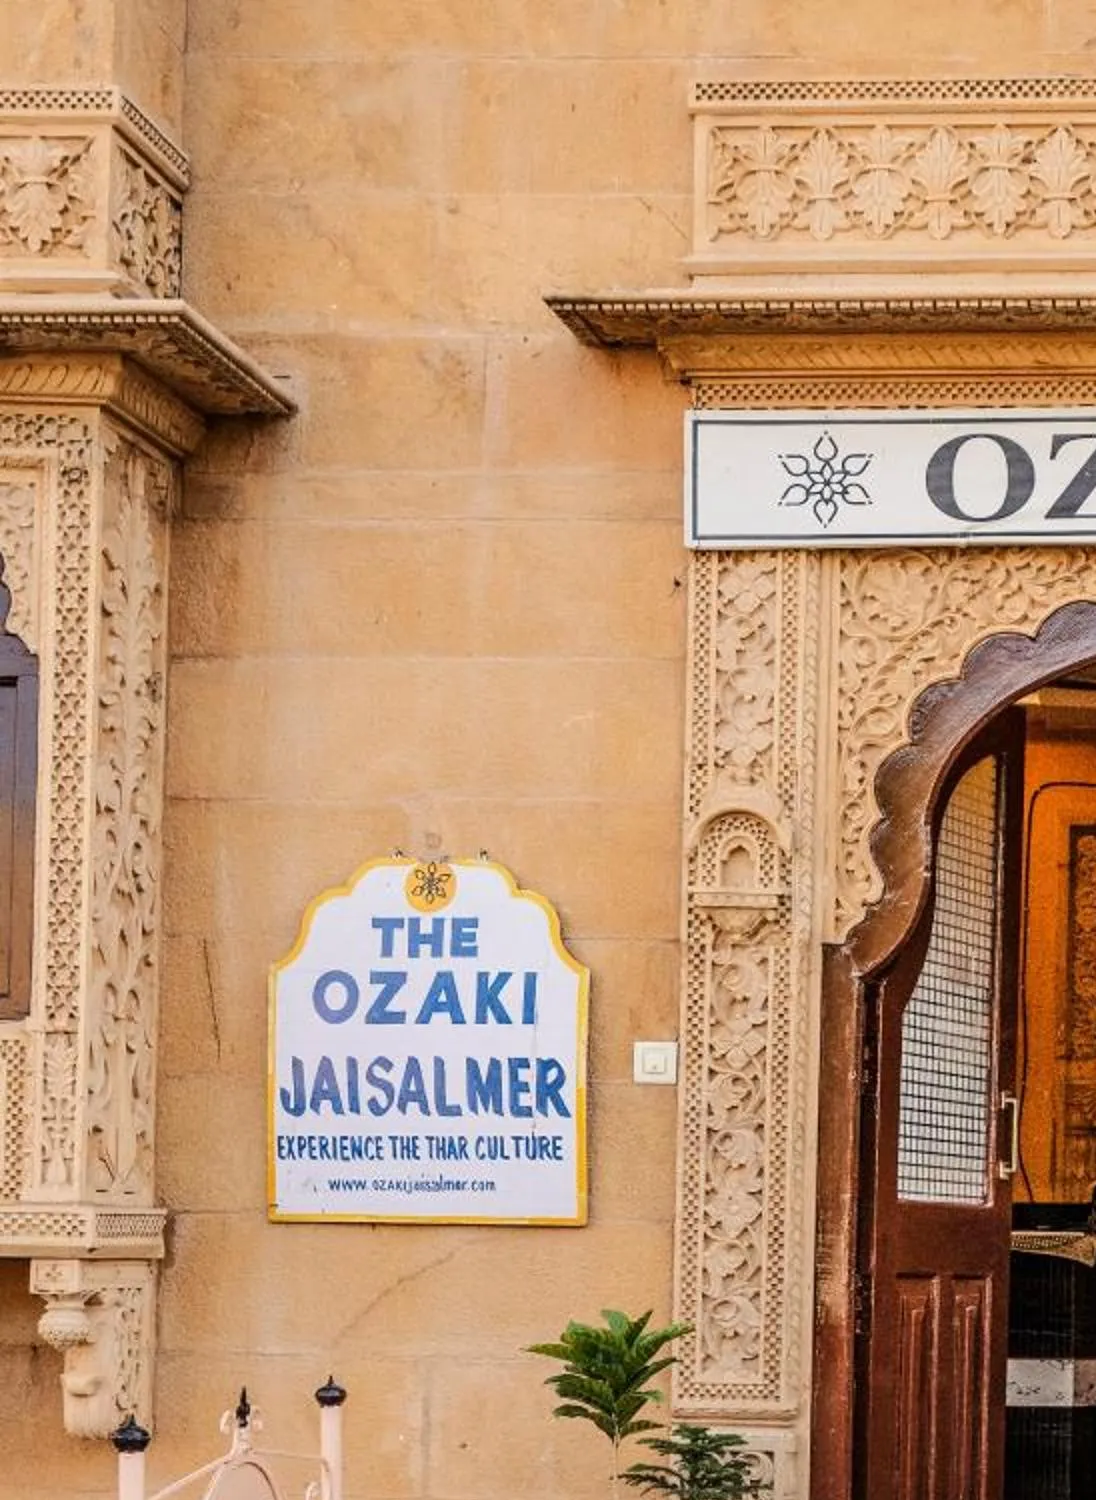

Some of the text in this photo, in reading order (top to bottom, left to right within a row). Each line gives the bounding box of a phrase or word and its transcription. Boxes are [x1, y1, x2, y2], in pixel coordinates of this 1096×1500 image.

[371, 916, 480, 959] THE
[311, 969, 538, 1026] OZAKI
[278, 1054, 573, 1119] JAISALMER
[276, 1134, 565, 1162] EXPERIENCE THE THAR CULTURE
